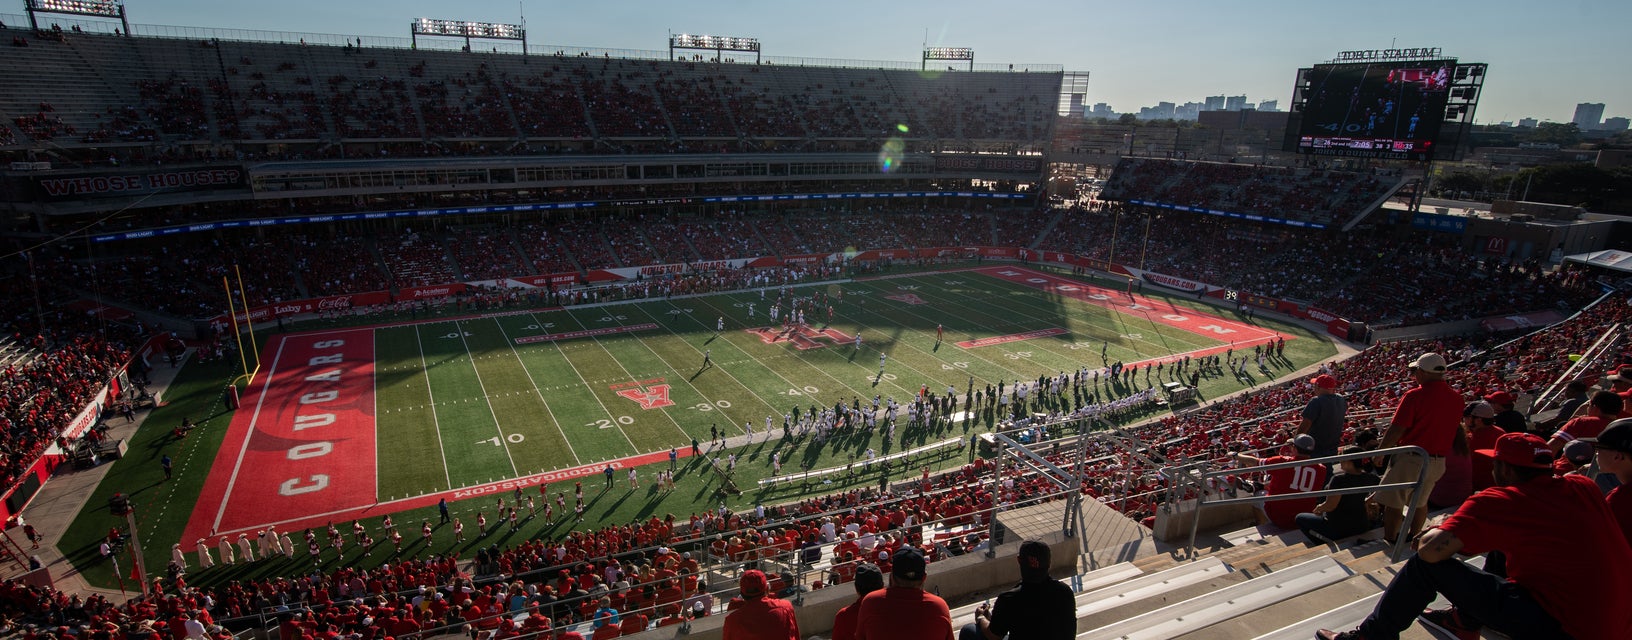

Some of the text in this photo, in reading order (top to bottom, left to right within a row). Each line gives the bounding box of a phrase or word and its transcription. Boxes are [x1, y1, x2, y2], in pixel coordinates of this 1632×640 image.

[1341, 48, 1435, 61] TDECU STADIUM
[1379, 151, 1408, 159] FIELD
[40, 168, 240, 197] WHOSE HOUSE?
[641, 264, 683, 276] HOUSTON
[422, 288, 449, 296] Academy
[1226, 290, 1237, 300] 39
[996, 270, 1237, 334] HOUSTON
[274, 304, 312, 315] Lubys
[788, 385, 819, 397] 40
[695, 400, 731, 412] 30
[277, 337, 345, 497] COUGARS
[595, 415, 635, 430] 20
[486, 432, 525, 447] 10
[454, 461, 624, 499] UHCOUGARS.COM
[1289, 466, 1316, 492] 10
